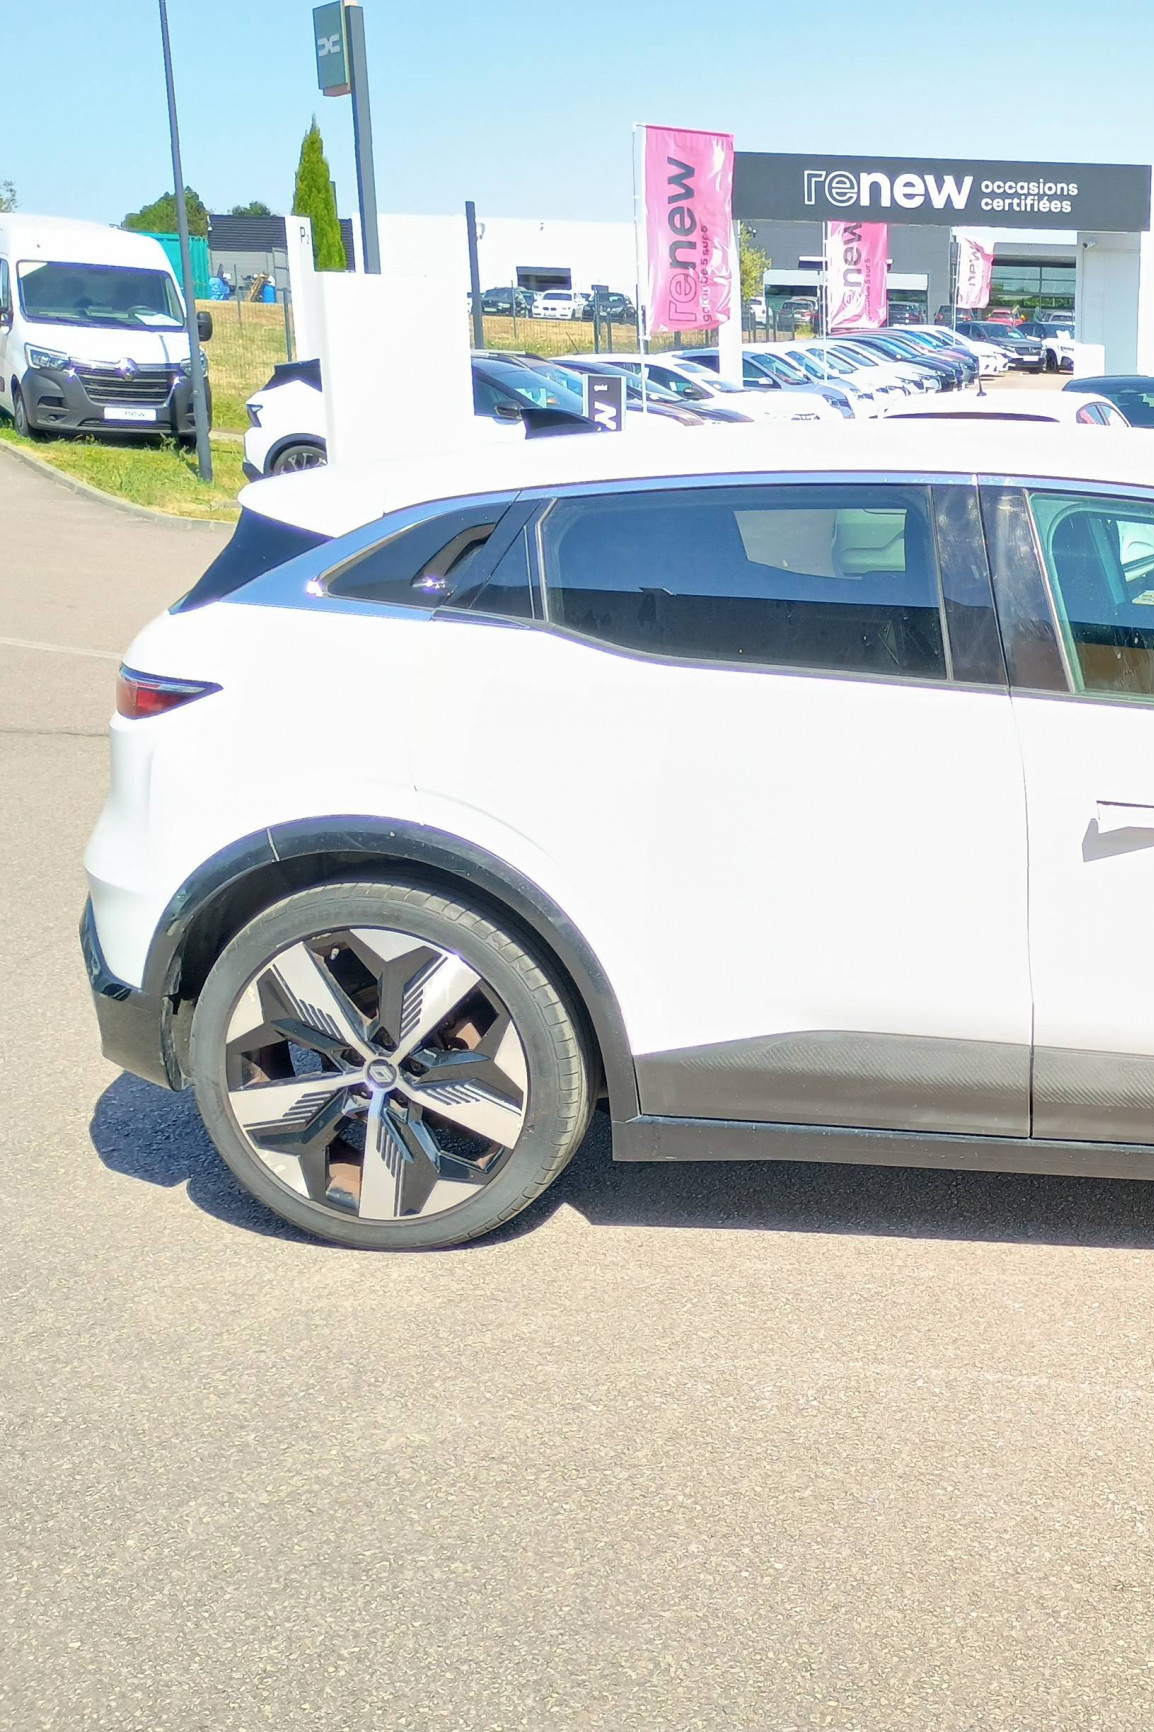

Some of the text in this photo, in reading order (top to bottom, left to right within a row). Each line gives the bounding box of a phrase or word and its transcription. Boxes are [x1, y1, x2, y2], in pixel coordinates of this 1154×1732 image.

[803, 169, 974, 210] renew
[981, 179, 1079, 196] occasions
[981, 195, 1072, 213] certifiées
[667, 156, 698, 323] renew
